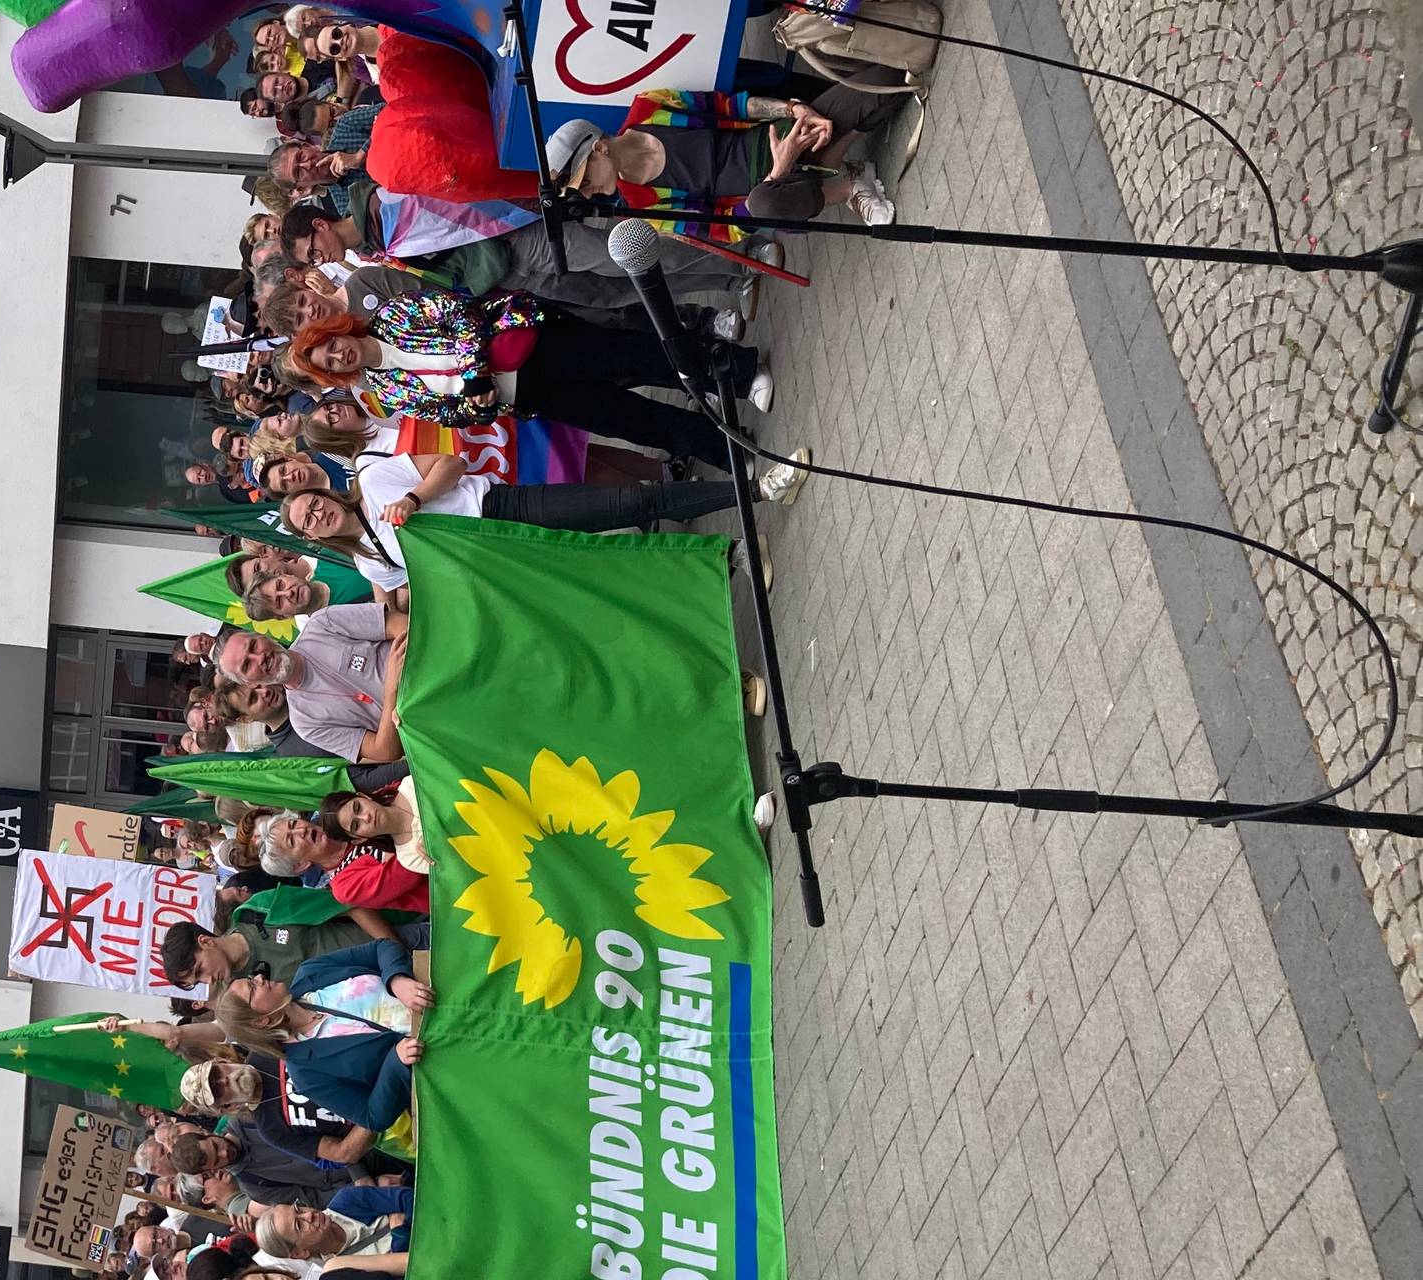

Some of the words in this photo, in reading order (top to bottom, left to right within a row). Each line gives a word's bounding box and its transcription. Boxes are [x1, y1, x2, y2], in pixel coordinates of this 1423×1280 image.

[109, 194, 137, 216] 77
[99, 898, 144, 975] NIE
[594, 930, 645, 1010] 90
[644, 947, 716, 1192] GRÜNEN
[57, 1122, 111, 1261] Faschismus
[575, 1025, 645, 1280] BÜNDNIS
